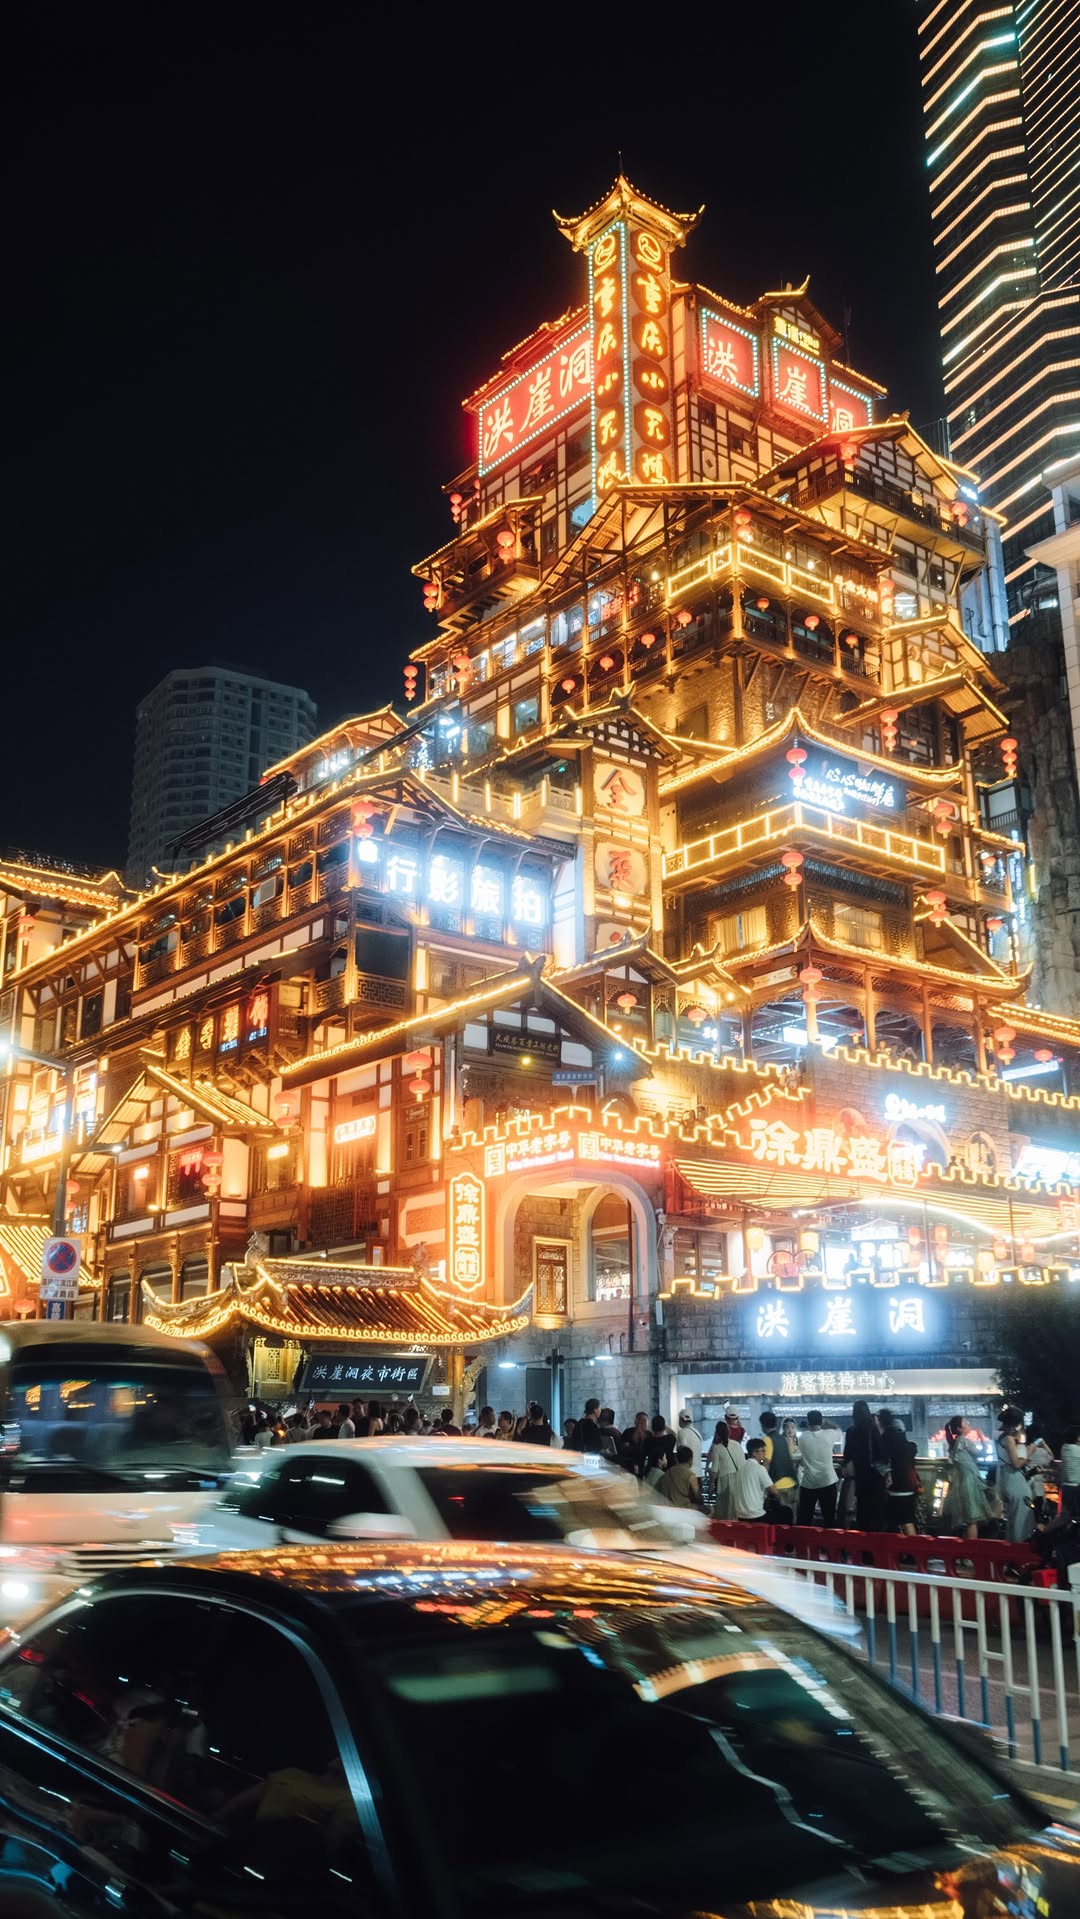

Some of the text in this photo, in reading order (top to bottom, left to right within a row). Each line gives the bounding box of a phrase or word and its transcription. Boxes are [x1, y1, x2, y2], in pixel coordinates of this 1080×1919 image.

[484, 339, 592, 458] 洪崖洞
[387, 855, 543, 924] 行影旅拍
[750, 1119, 888, 1183] 徐鼎盛
[455, 1183, 480, 1246] 徐鼎盛
[757, 1296, 925, 1338] 洪崖洞
[312, 1364, 418, 1382] 洪崖洞夜市街區
[781, 1371, 896, 1392] 游客接待中心
